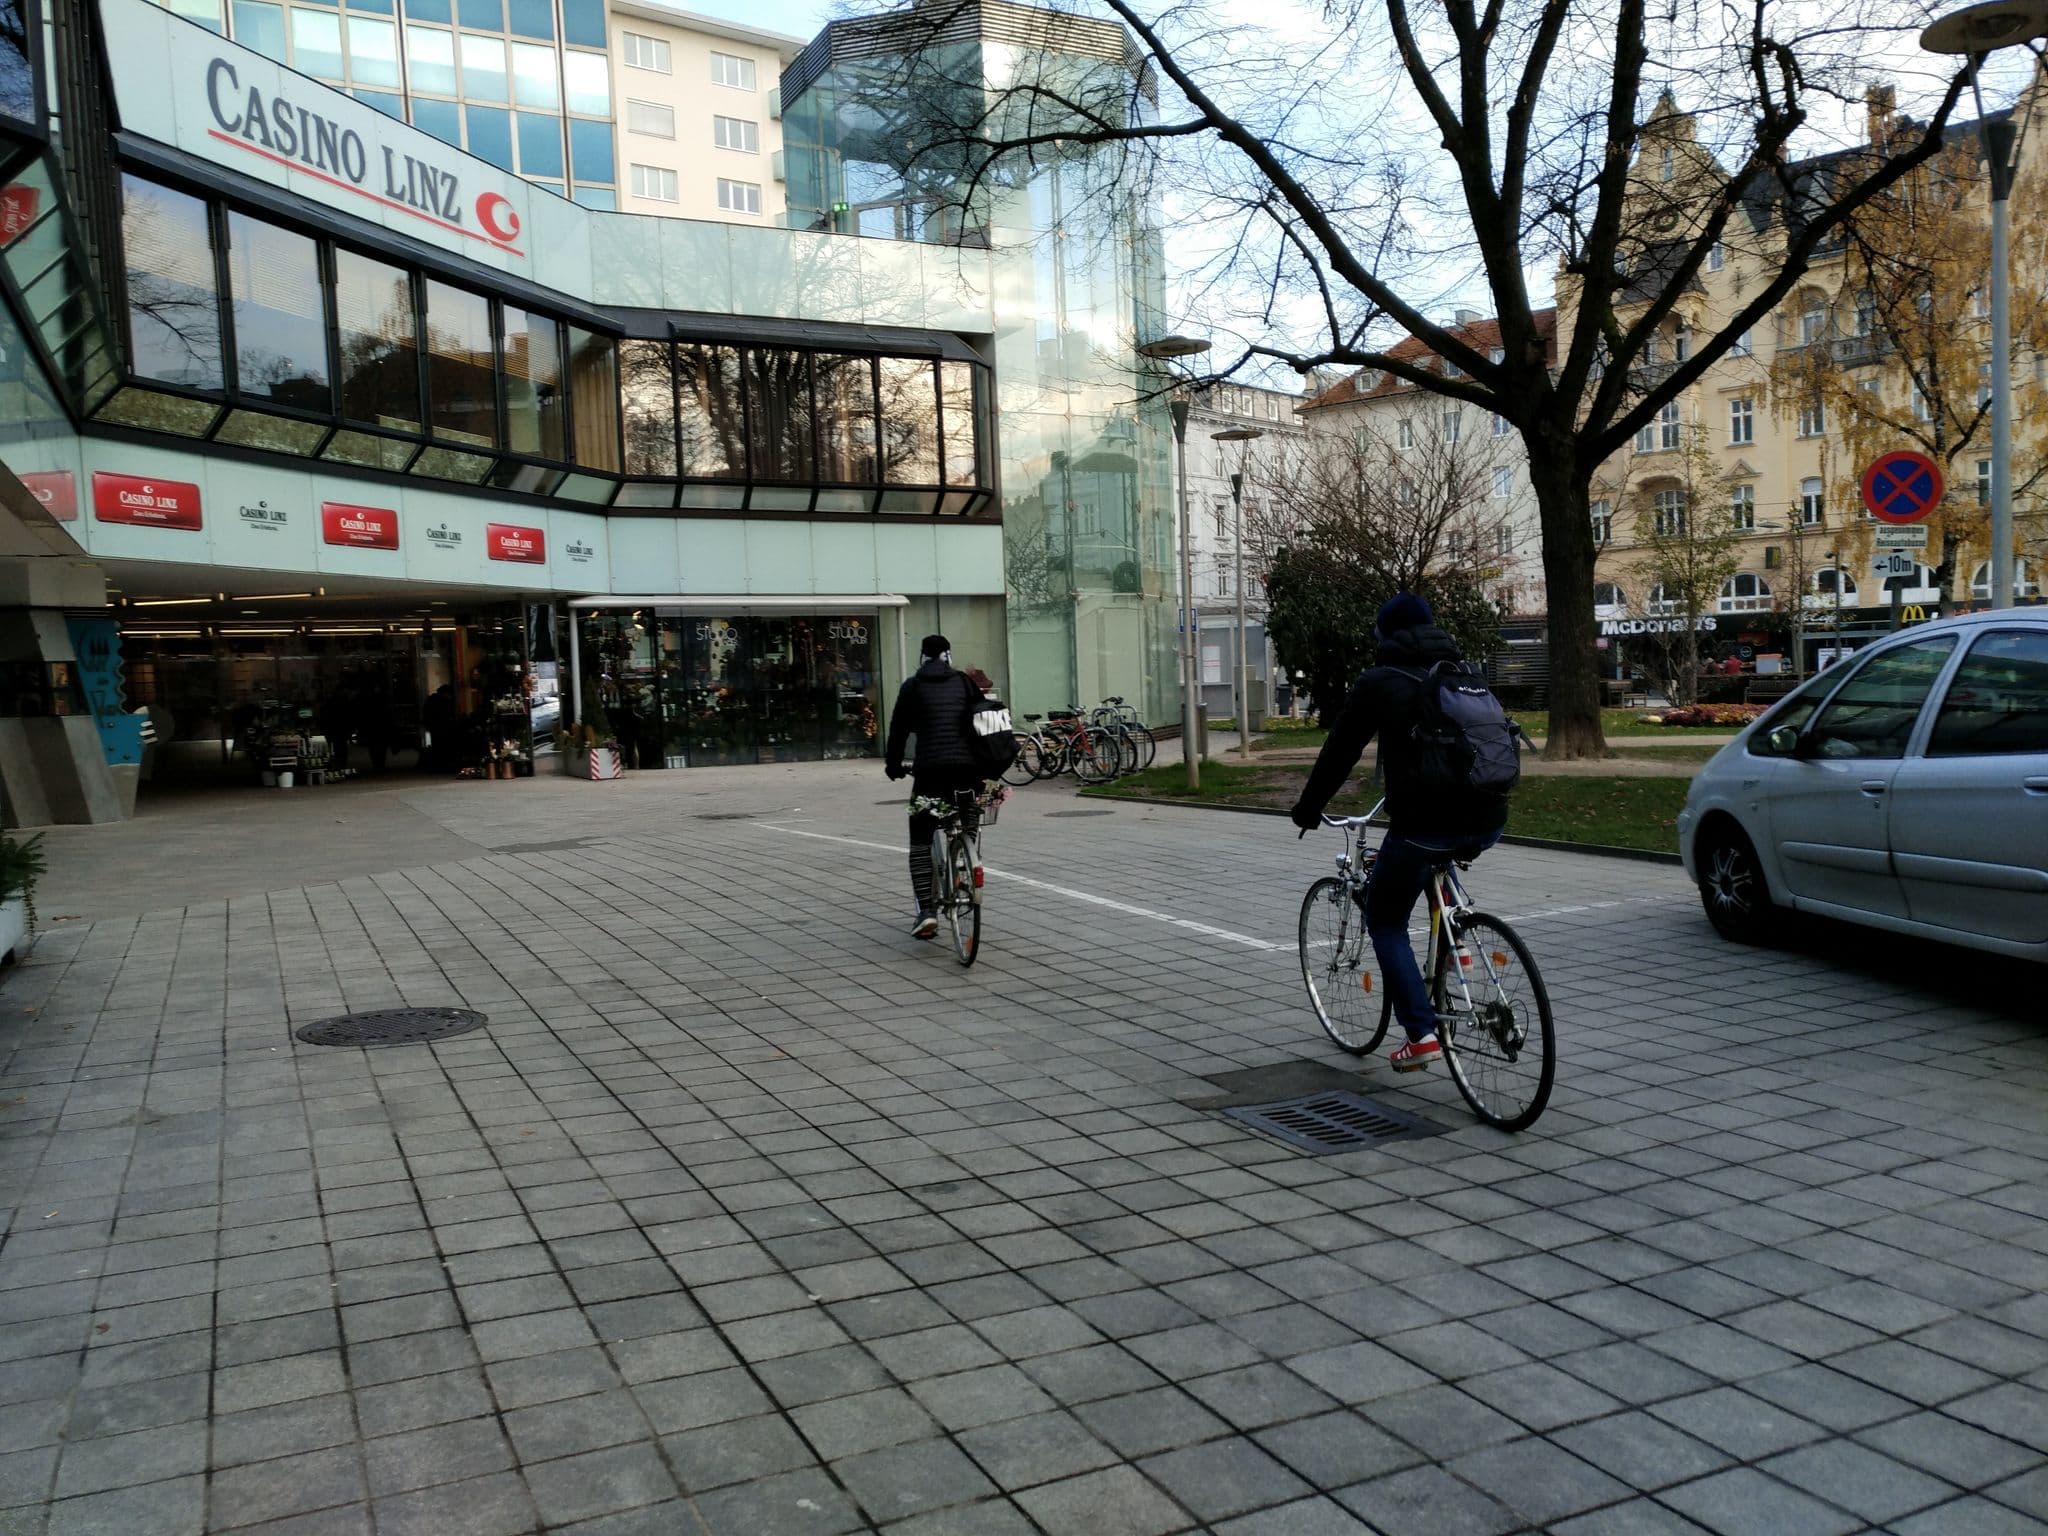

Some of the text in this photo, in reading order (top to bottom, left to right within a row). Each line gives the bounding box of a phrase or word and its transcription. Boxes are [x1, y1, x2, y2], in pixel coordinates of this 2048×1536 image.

[206, 57, 462, 224] CASINO LINZ
[119, 490, 178, 509] CASINO LINZ
[239, 505, 287, 522] CASINO LINZ
[340, 517, 382, 532] CASINO LINZ
[426, 528, 462, 541] CASINO LINZ
